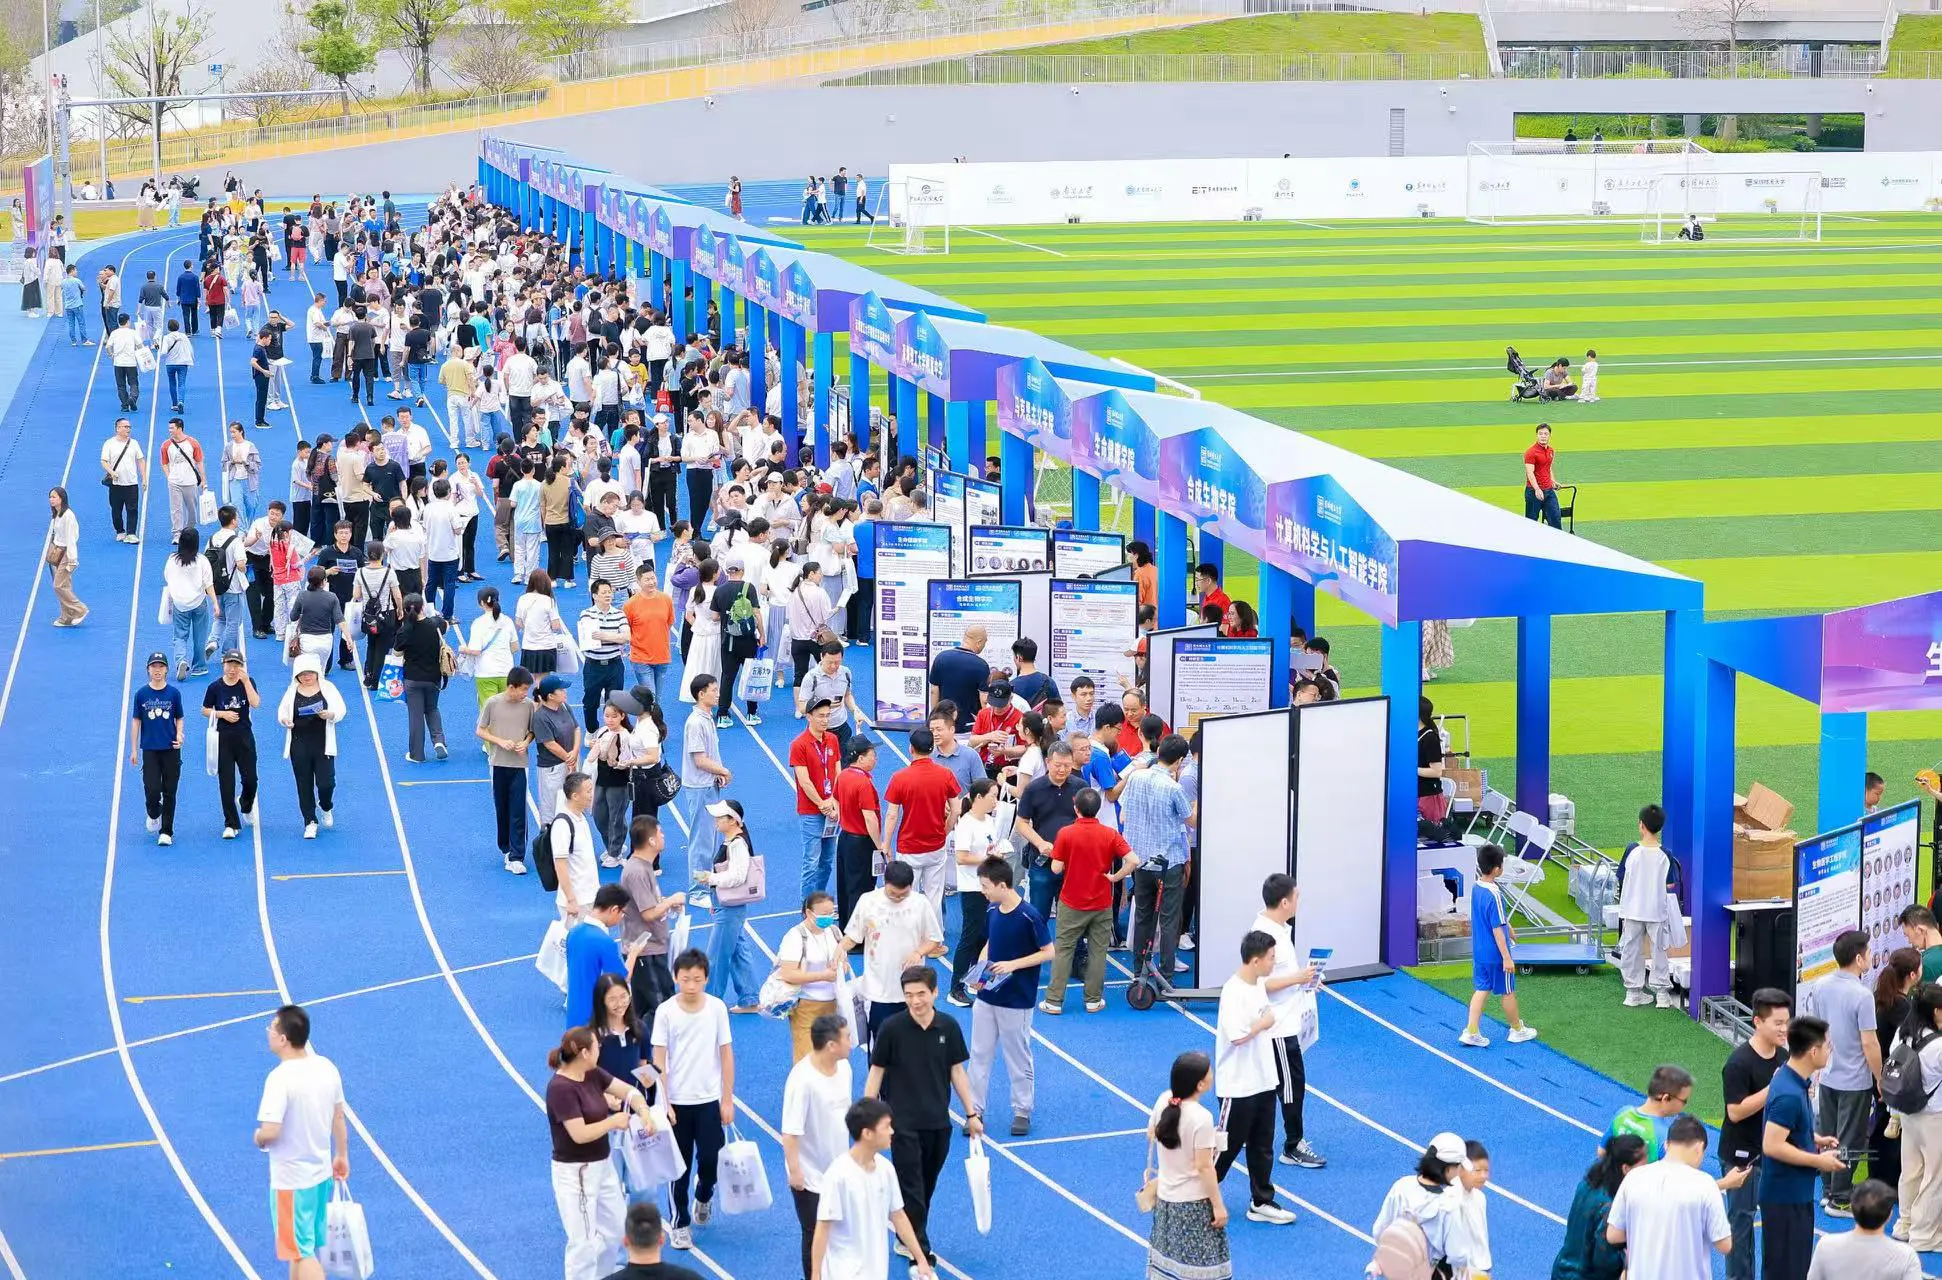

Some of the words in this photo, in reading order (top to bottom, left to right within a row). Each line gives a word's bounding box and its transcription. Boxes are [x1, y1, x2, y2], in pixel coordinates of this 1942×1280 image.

[1014, 395, 1054, 434] 马克思主义学院
[1094, 432, 1135, 473] 生命健康学院
[1187, 474, 1236, 520] 合成生物学院
[1275, 512, 1388, 594] 计算机科学与人工智能学院
